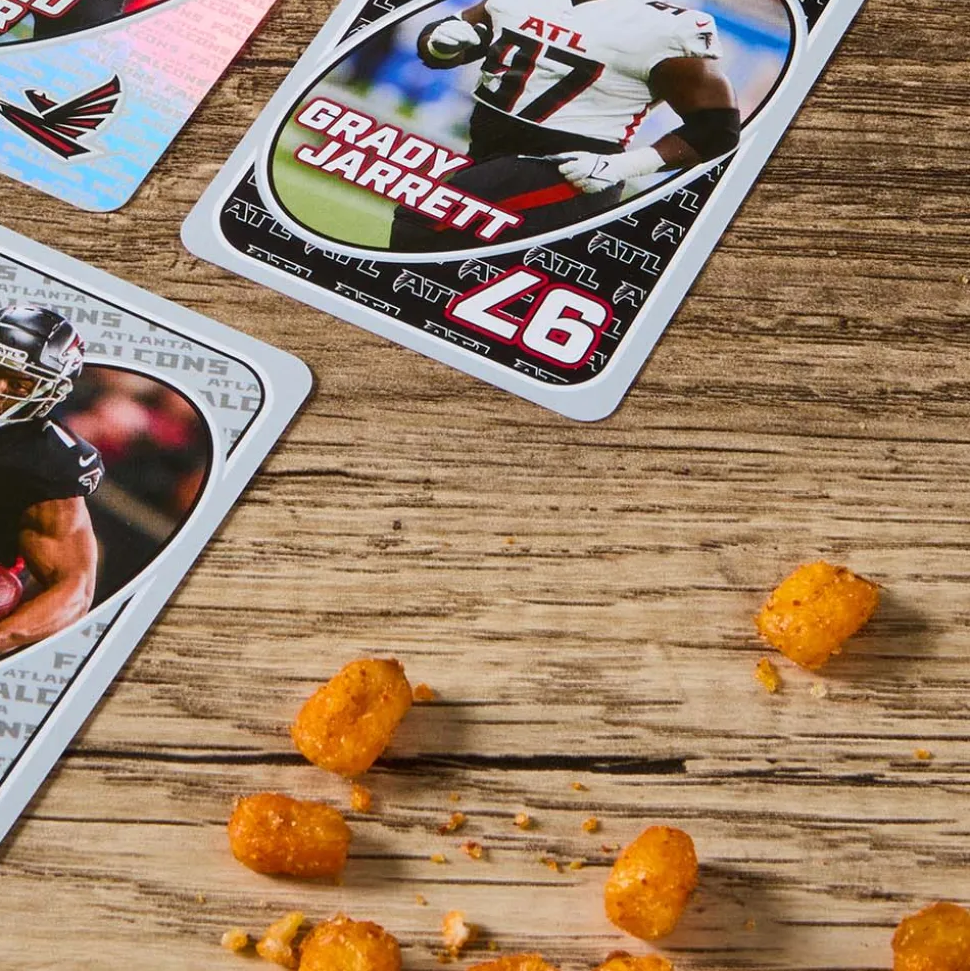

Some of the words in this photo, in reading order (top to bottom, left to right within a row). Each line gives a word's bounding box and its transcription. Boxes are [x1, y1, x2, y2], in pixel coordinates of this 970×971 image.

[519, 16, 586, 52] ATL
[473, 28, 605, 124] 97
[297, 98, 470, 180] GRADY
[297, 141, 520, 241] JARRETT
[523, 245, 599, 290] ATL
[587, 230, 662, 276] ATL
[100, 330, 193, 351] ATLANTA
[447, 266, 612, 368] 97
